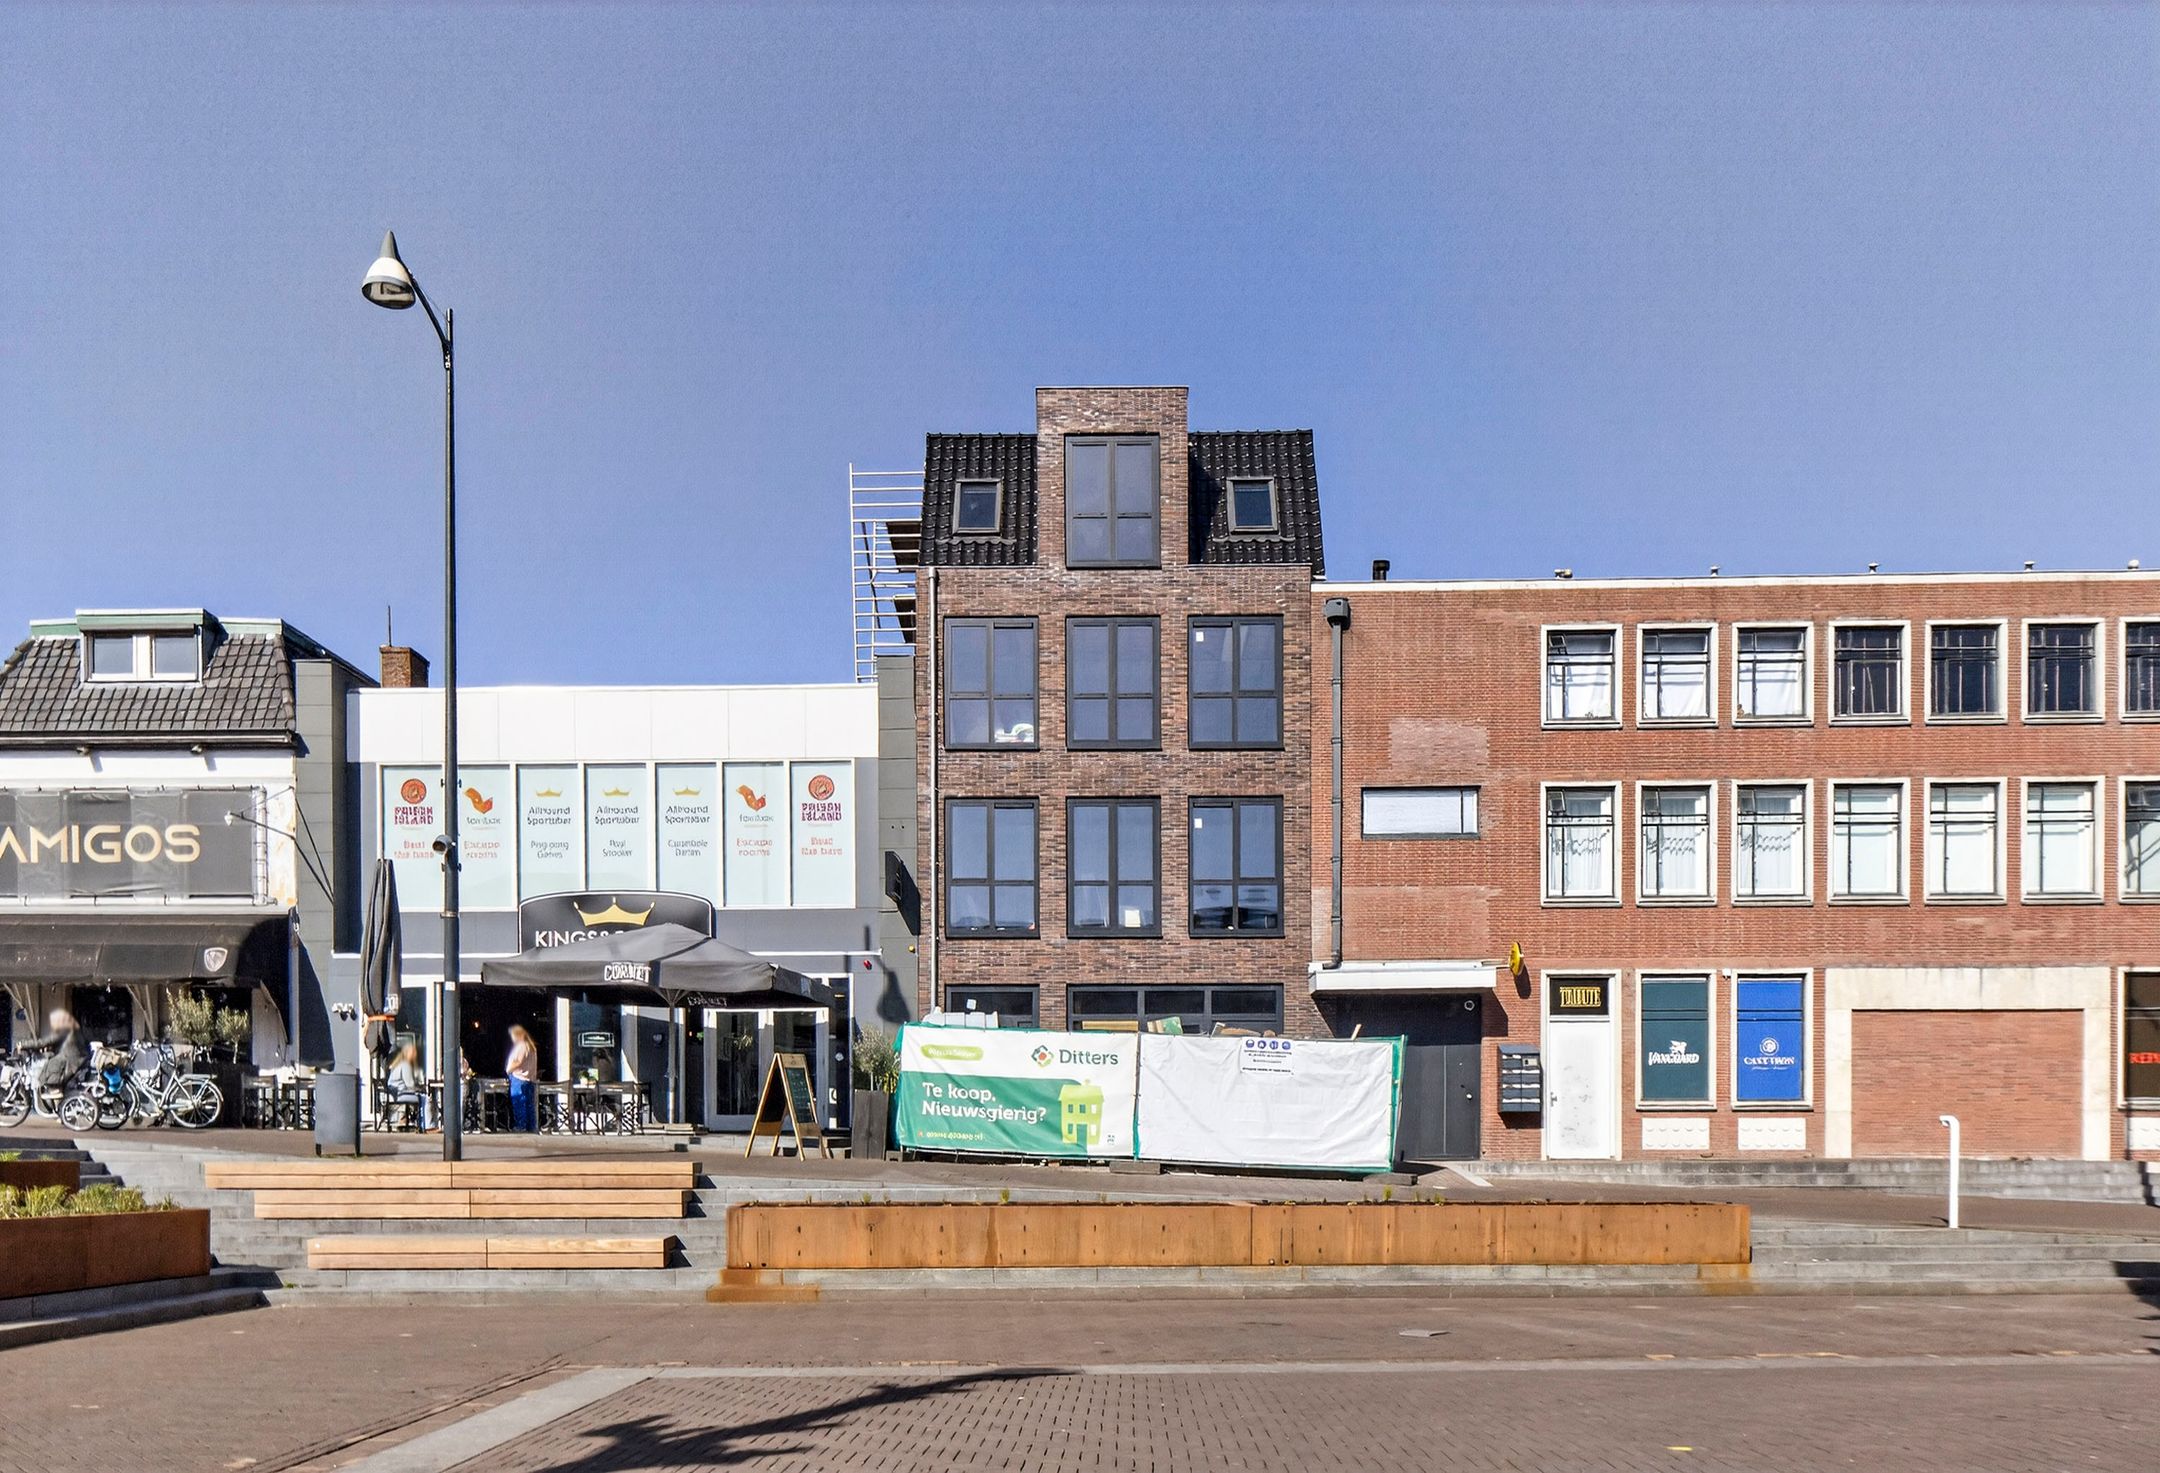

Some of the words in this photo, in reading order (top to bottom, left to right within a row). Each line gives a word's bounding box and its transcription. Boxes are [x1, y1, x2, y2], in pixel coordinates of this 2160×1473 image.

[0, 825, 201, 863] AMIGOS
[1059, 1048, 1119, 1066] Ditters
[922, 1081, 943, 1098] Te
[921, 1100, 1047, 1125] Nieuwsgierig?
